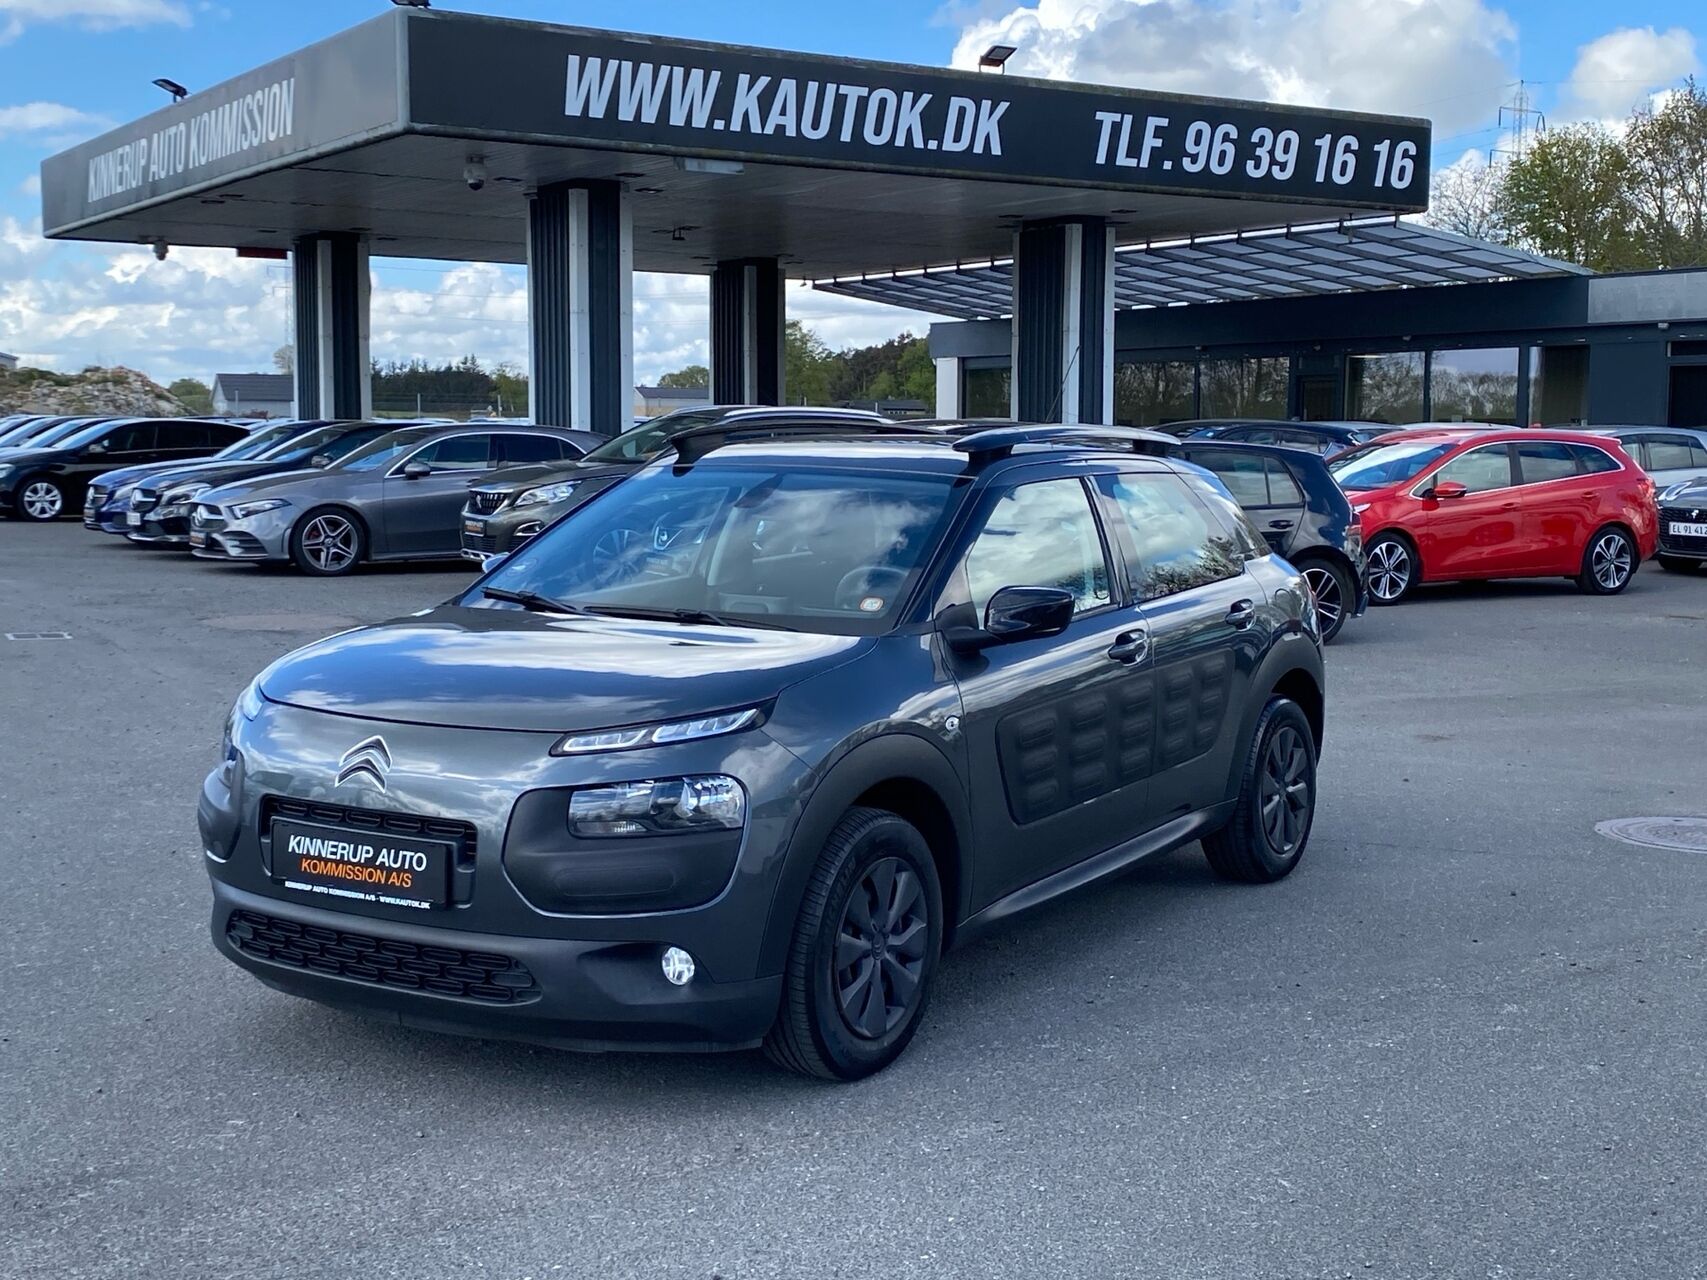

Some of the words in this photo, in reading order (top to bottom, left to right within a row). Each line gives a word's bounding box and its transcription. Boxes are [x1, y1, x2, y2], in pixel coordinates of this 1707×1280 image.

[564, 54, 1011, 157] WWW.KAUTOK.DK
[87, 138, 147, 203] KINNERUP
[149, 122, 185, 182] AUTO
[189, 78, 295, 169] KOMMISSION
[1094, 111, 1173, 170] TLF.
[1182, 120, 1238, 175] 96
[1245, 127, 1300, 181] 39
[1314, 133, 1359, 186] 16
[1373, 139, 1417, 190] 16
[1672, 524, 1681, 533] EL
[1683, 525, 1692, 534] 91
[288, 835, 374, 864] KINNERUP
[375, 848, 427, 872] AUTO
[301, 859, 386, 884] KOMMISSION
[389, 871, 412, 888] A/S
